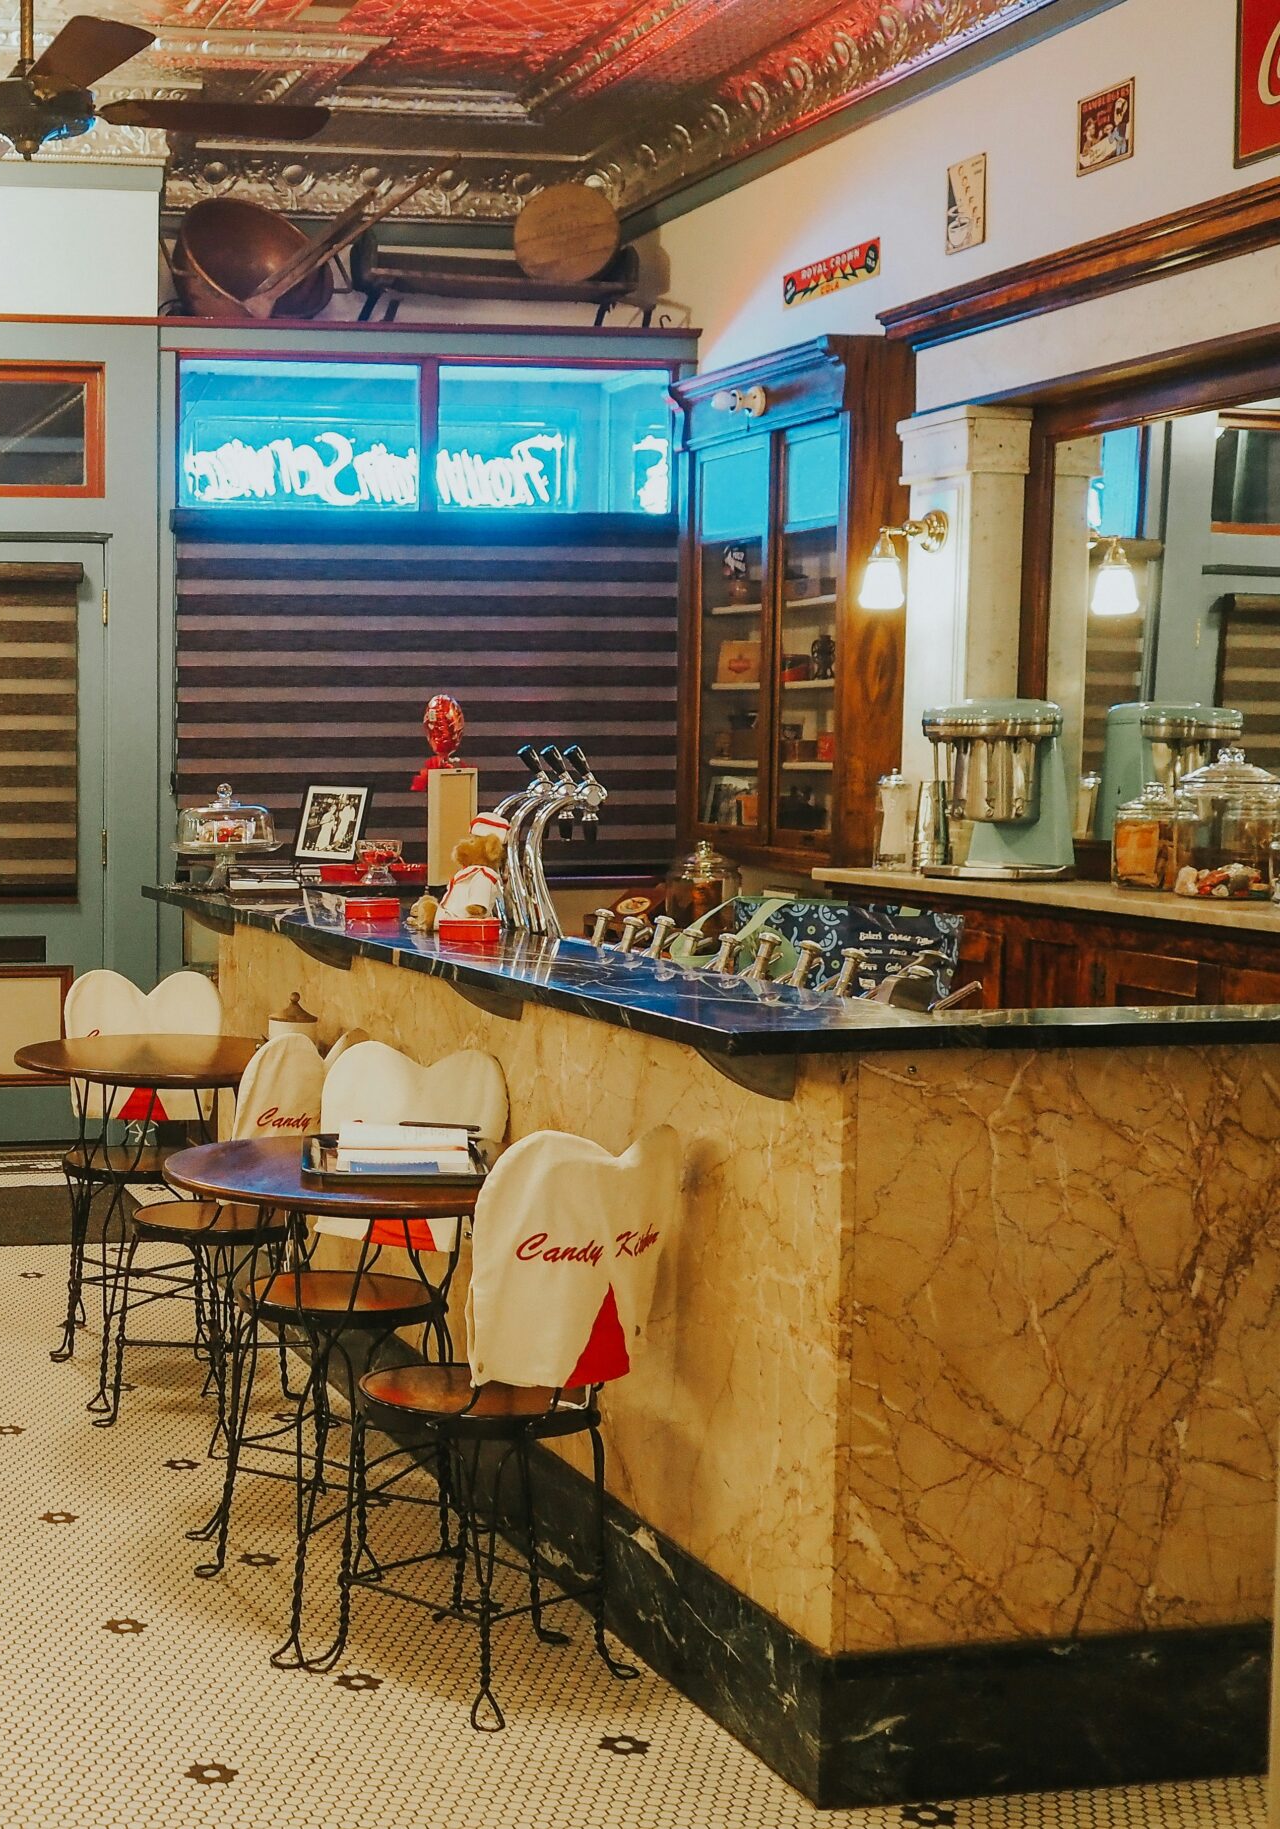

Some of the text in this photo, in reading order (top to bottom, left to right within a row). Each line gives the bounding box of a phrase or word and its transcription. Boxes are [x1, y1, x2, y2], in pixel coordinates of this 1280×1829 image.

[800, 261, 829, 280] ROYAL
[829, 246, 861, 268] CROWN
[256, 1107, 312, 1132] Candy
[516, 1232, 604, 1267] Candy
